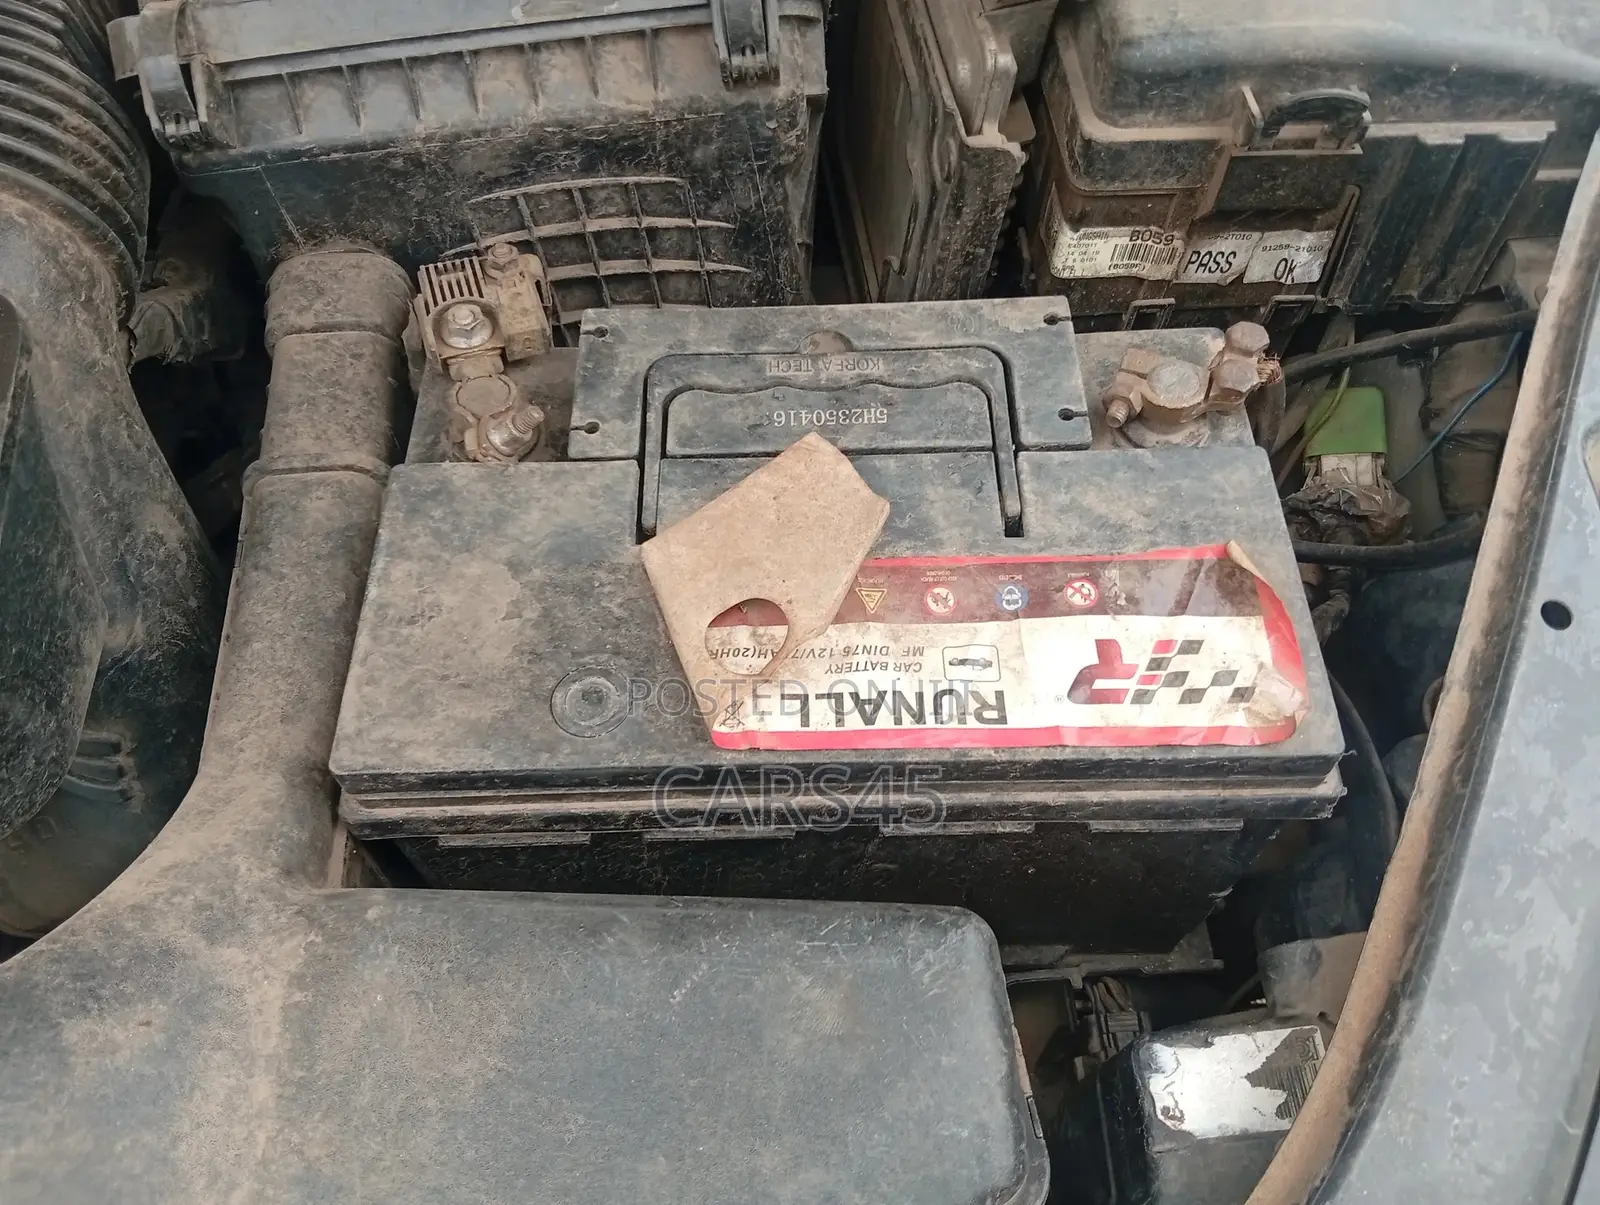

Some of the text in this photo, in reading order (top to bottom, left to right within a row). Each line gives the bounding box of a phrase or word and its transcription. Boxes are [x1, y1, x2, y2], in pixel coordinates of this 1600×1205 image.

[1183, 250, 1237, 274] PASS
[1273, 256, 1300, 283] OK
[768, 357, 881, 374] KOREA TECH
[842, 644, 891, 659] DIN75
[901, 645, 926, 657] MF
[824, 661, 923, 675] CAR BATTERY
[781, 689, 1008, 728] RUNALL
